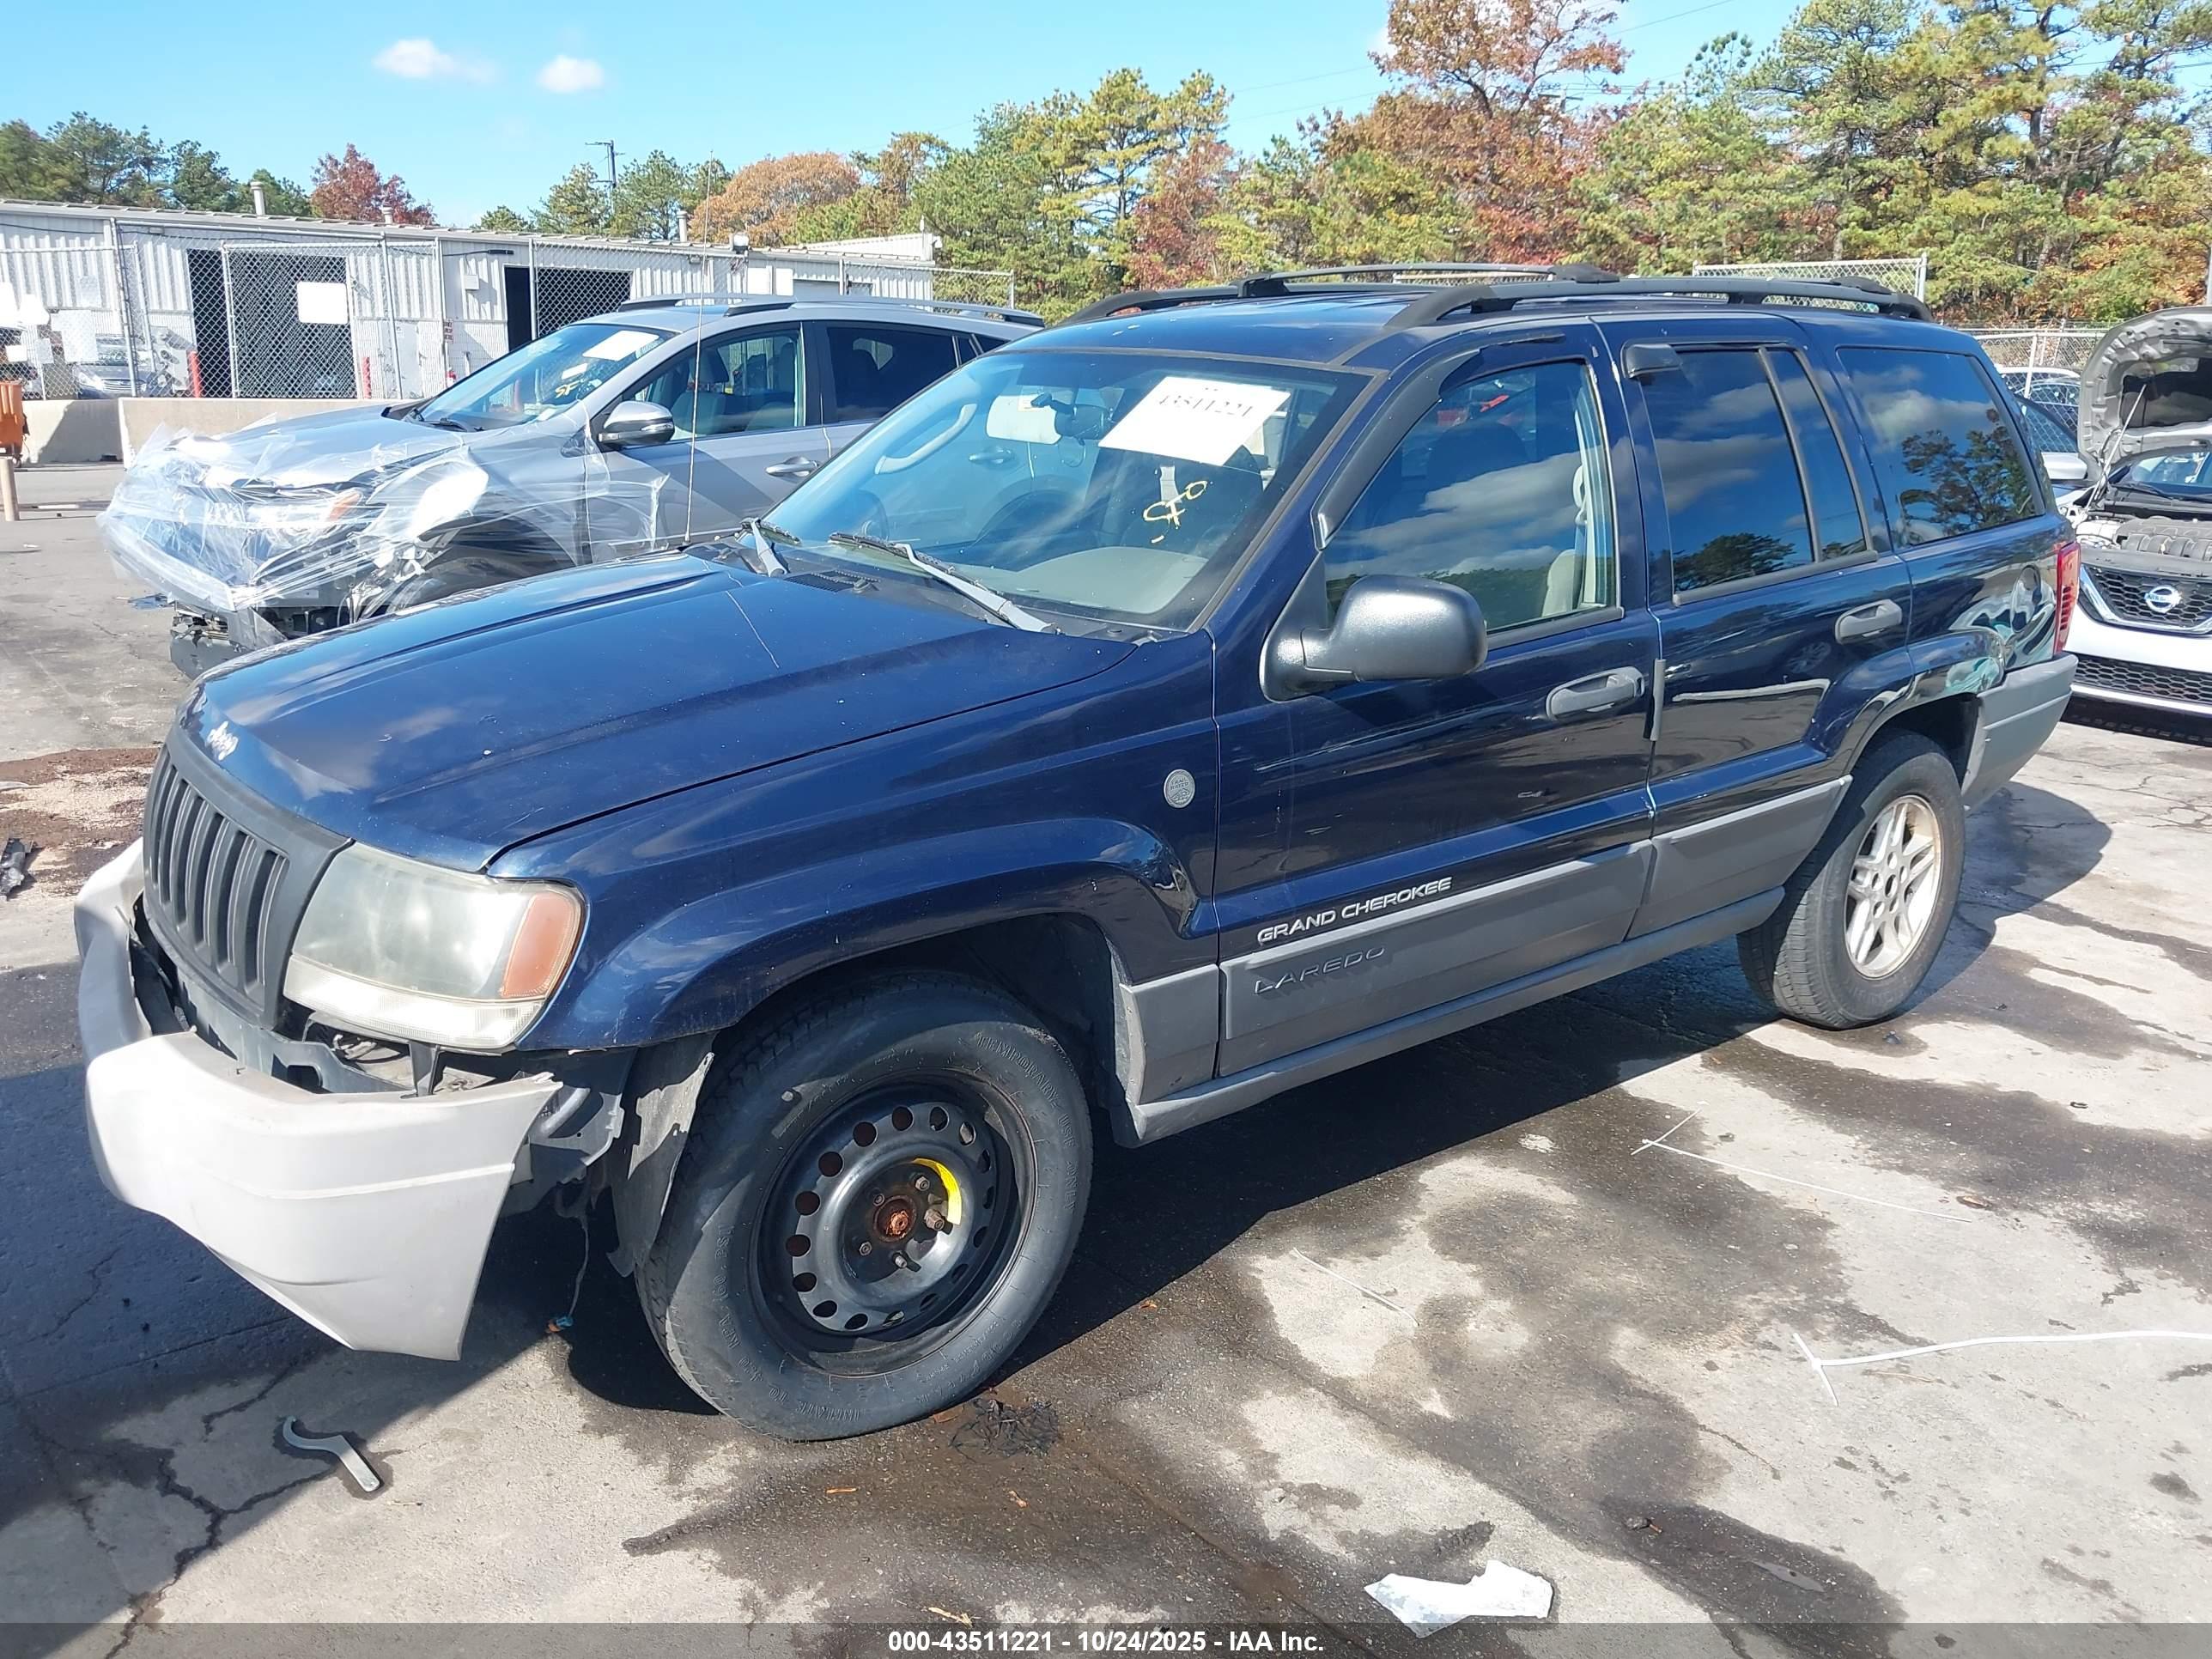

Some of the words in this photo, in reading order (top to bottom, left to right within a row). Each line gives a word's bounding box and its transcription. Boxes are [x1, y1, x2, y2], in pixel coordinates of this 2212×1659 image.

[1256, 910, 1336, 946] GRAND
[1340, 877, 1453, 919] CHEROKEE
[1254, 946, 1386, 995] LAREDO
